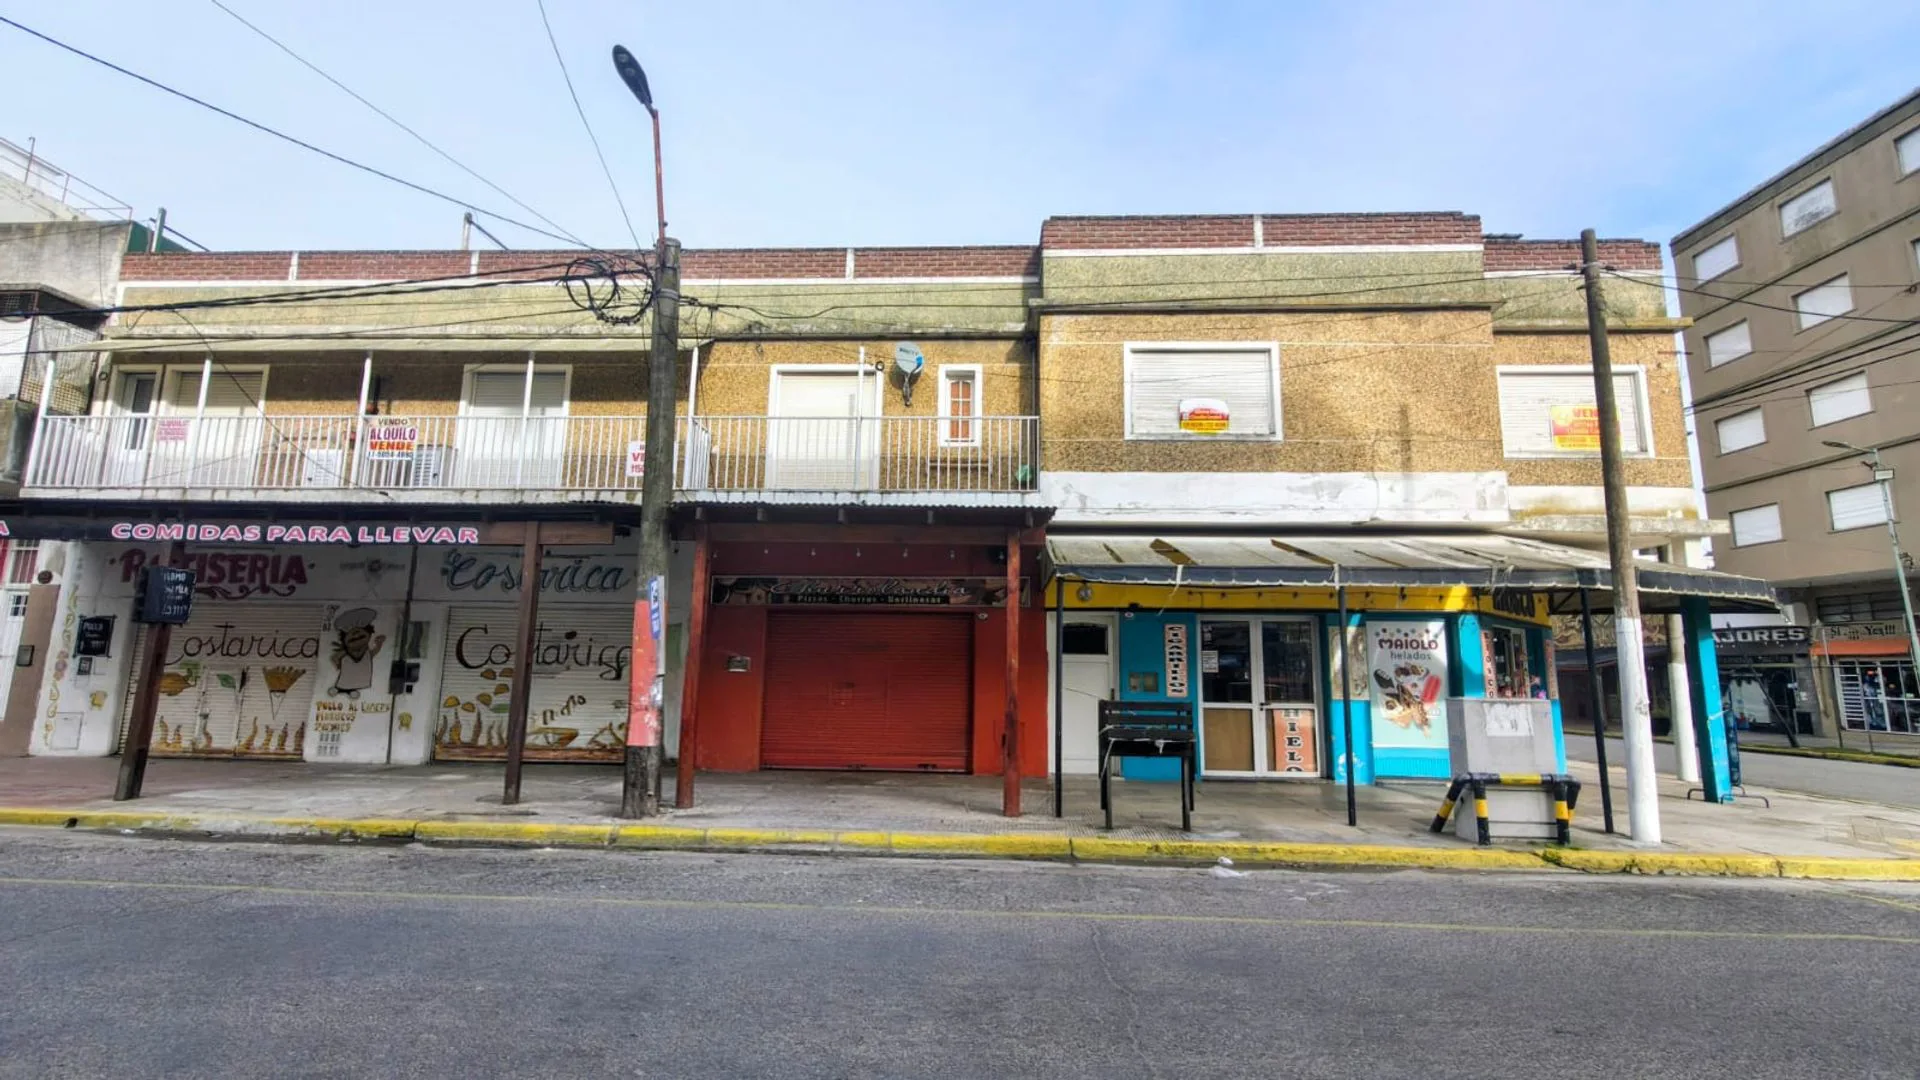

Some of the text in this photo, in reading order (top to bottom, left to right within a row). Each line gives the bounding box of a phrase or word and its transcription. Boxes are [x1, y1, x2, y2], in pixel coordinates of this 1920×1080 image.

[377, 418, 408, 426] VENDO
[370, 427, 416, 441] ALQUILO
[370, 441, 415, 451] VENDE
[111, 523, 478, 544] COMIDAS PARA LLEVAR
[165, 621, 320, 666] ostarica
[1391, 650, 1431, 660] helados
